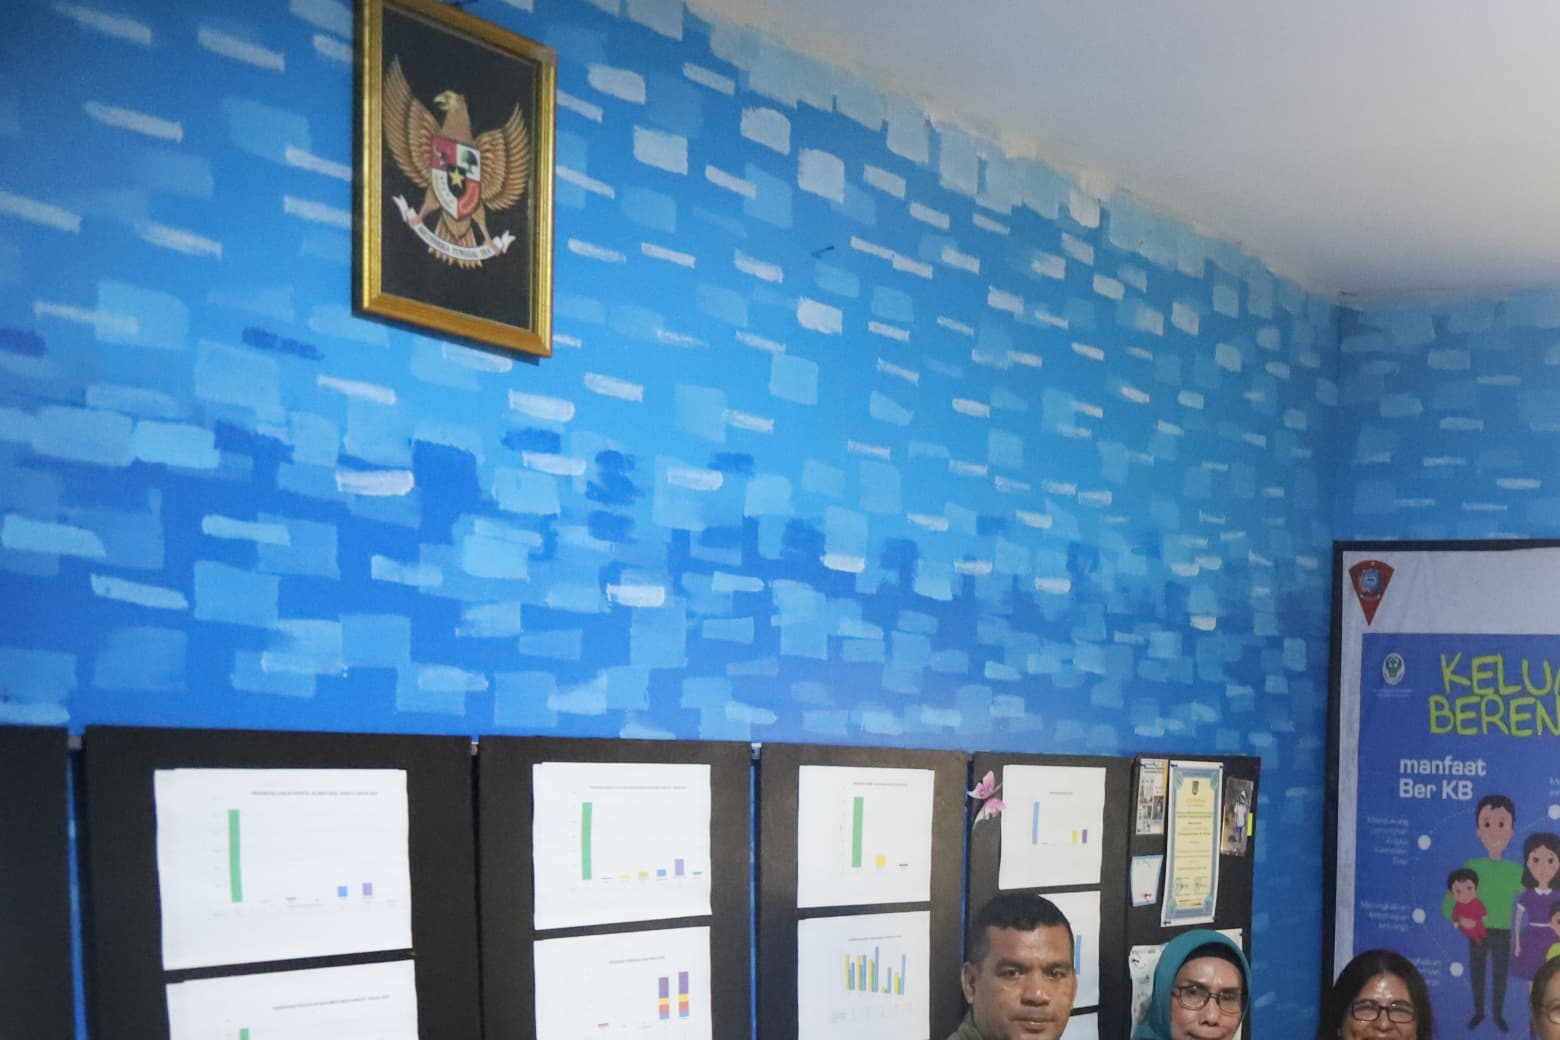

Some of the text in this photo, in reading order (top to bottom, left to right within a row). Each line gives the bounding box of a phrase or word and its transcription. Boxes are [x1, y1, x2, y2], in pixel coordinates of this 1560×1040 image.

[1399, 754, 1487, 777] manfaat
[1399, 778, 1474, 801] Ber KB
